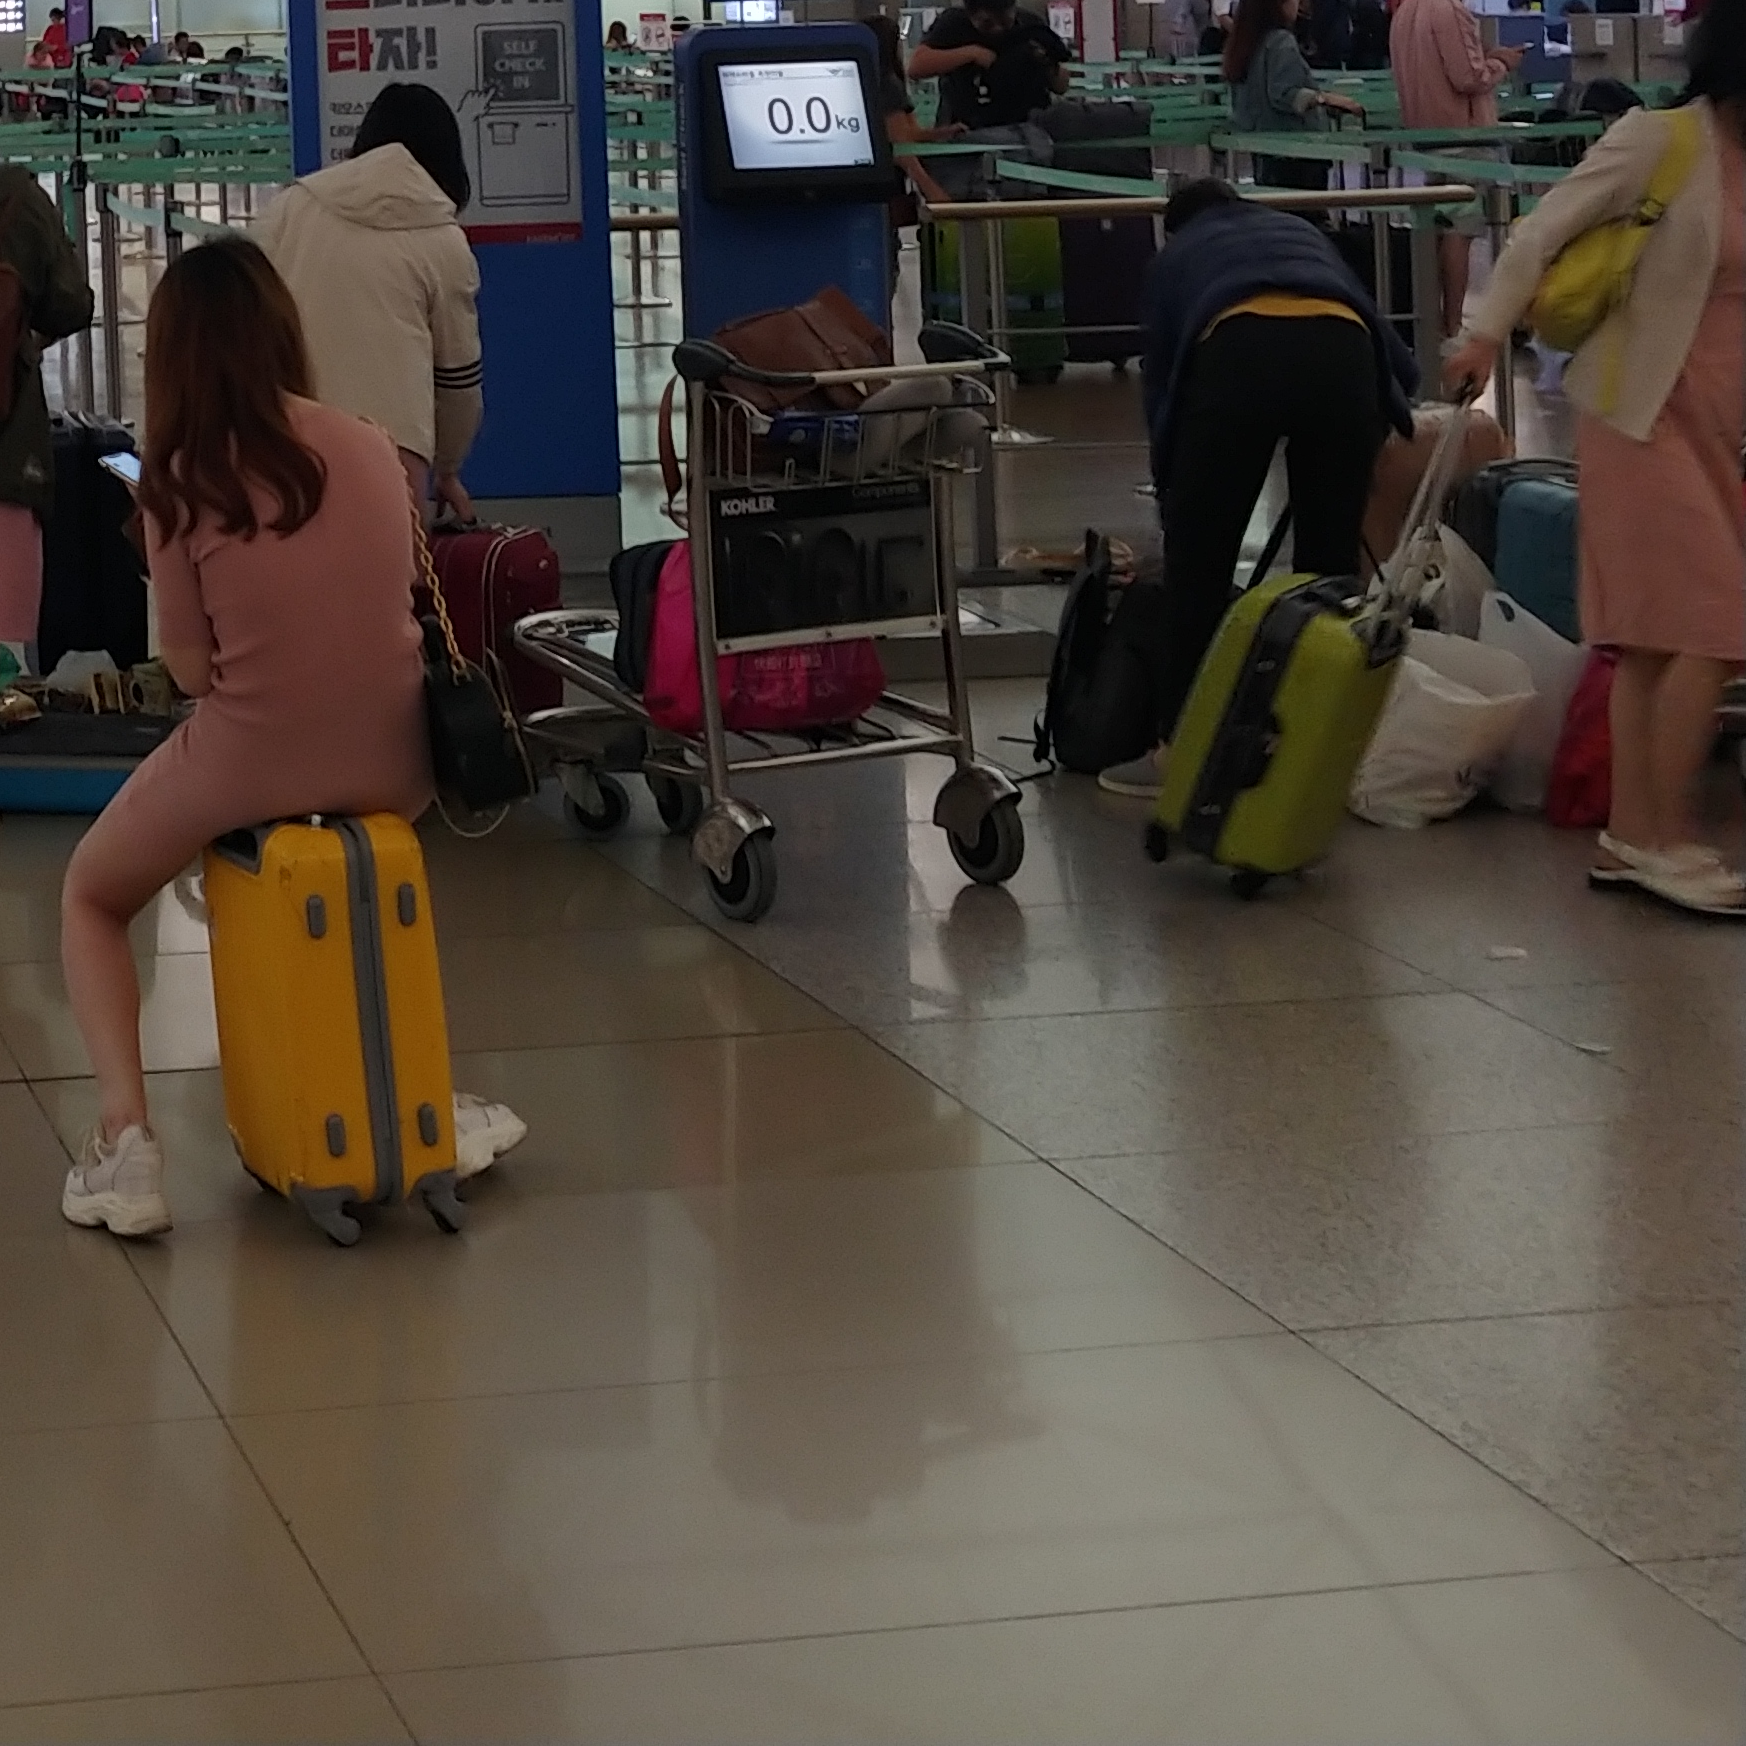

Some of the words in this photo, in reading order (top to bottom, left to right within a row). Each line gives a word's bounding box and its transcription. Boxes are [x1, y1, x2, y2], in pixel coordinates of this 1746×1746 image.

[326, 26, 438, 73] 타자!
[494, 57, 546, 72] CHECK
[513, 75, 530, 89] IN
[767, 97, 831, 135] 0.0
[835, 114, 861, 133] kg
[720, 495, 777, 517] KOHLER
